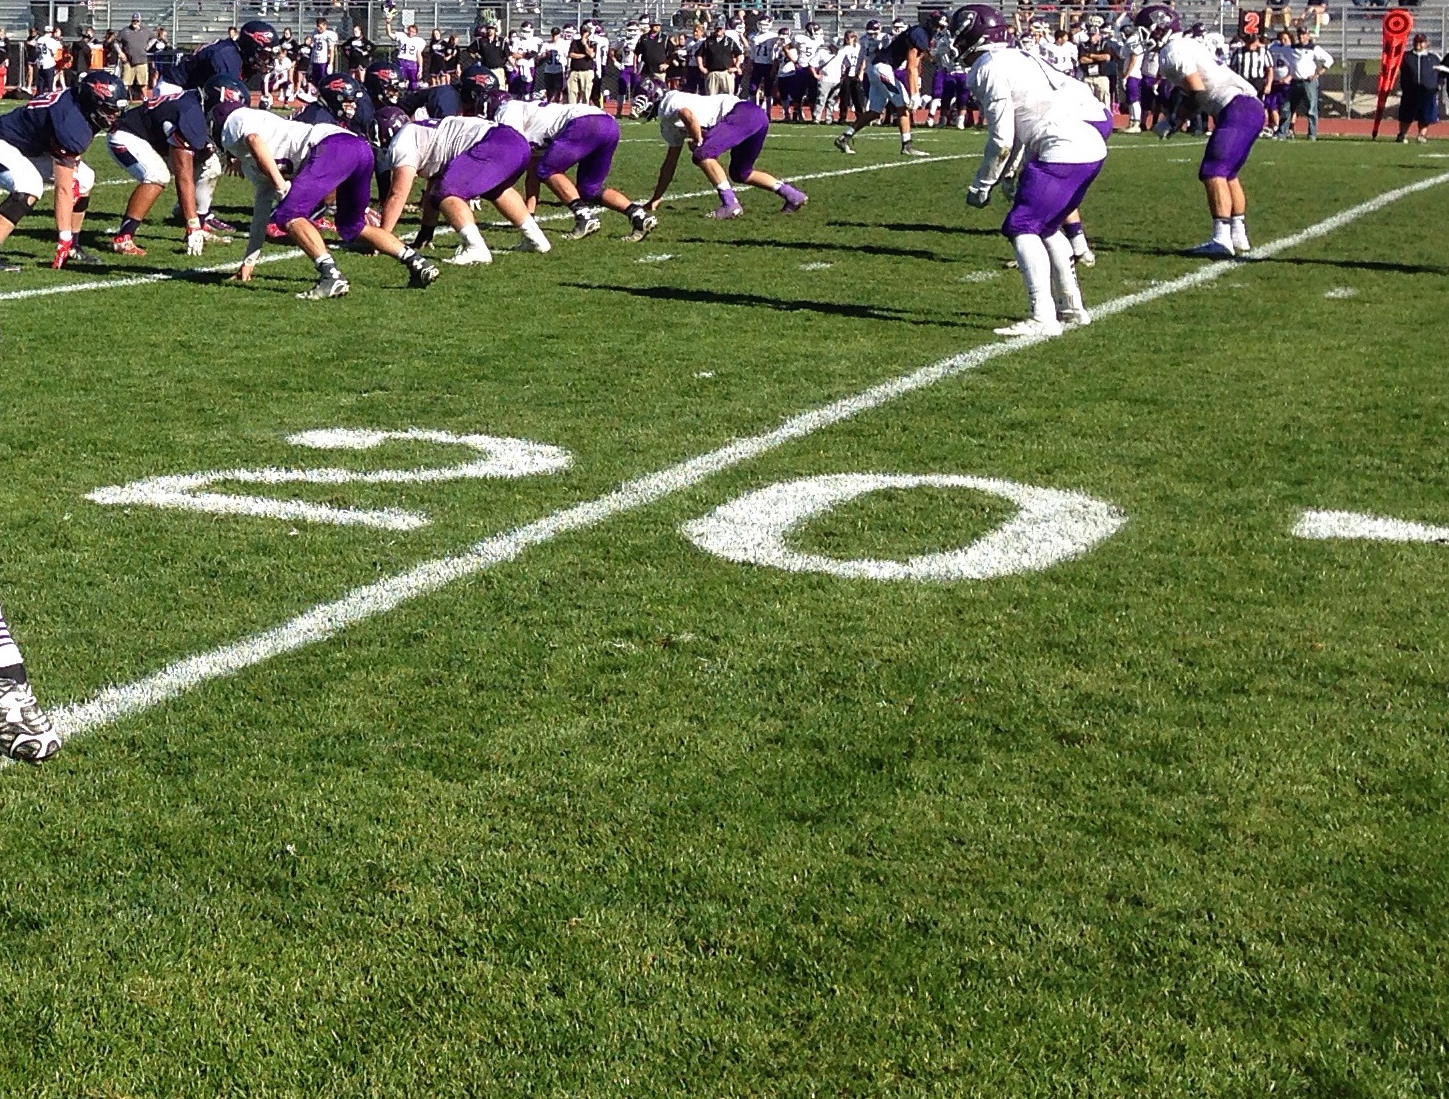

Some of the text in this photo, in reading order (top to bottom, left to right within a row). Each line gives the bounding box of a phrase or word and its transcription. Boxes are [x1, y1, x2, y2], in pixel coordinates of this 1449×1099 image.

[1244, 12, 1259, 34] 2
[400, 43, 416, 55] 42
[85, 427, 1131, 584] 20
